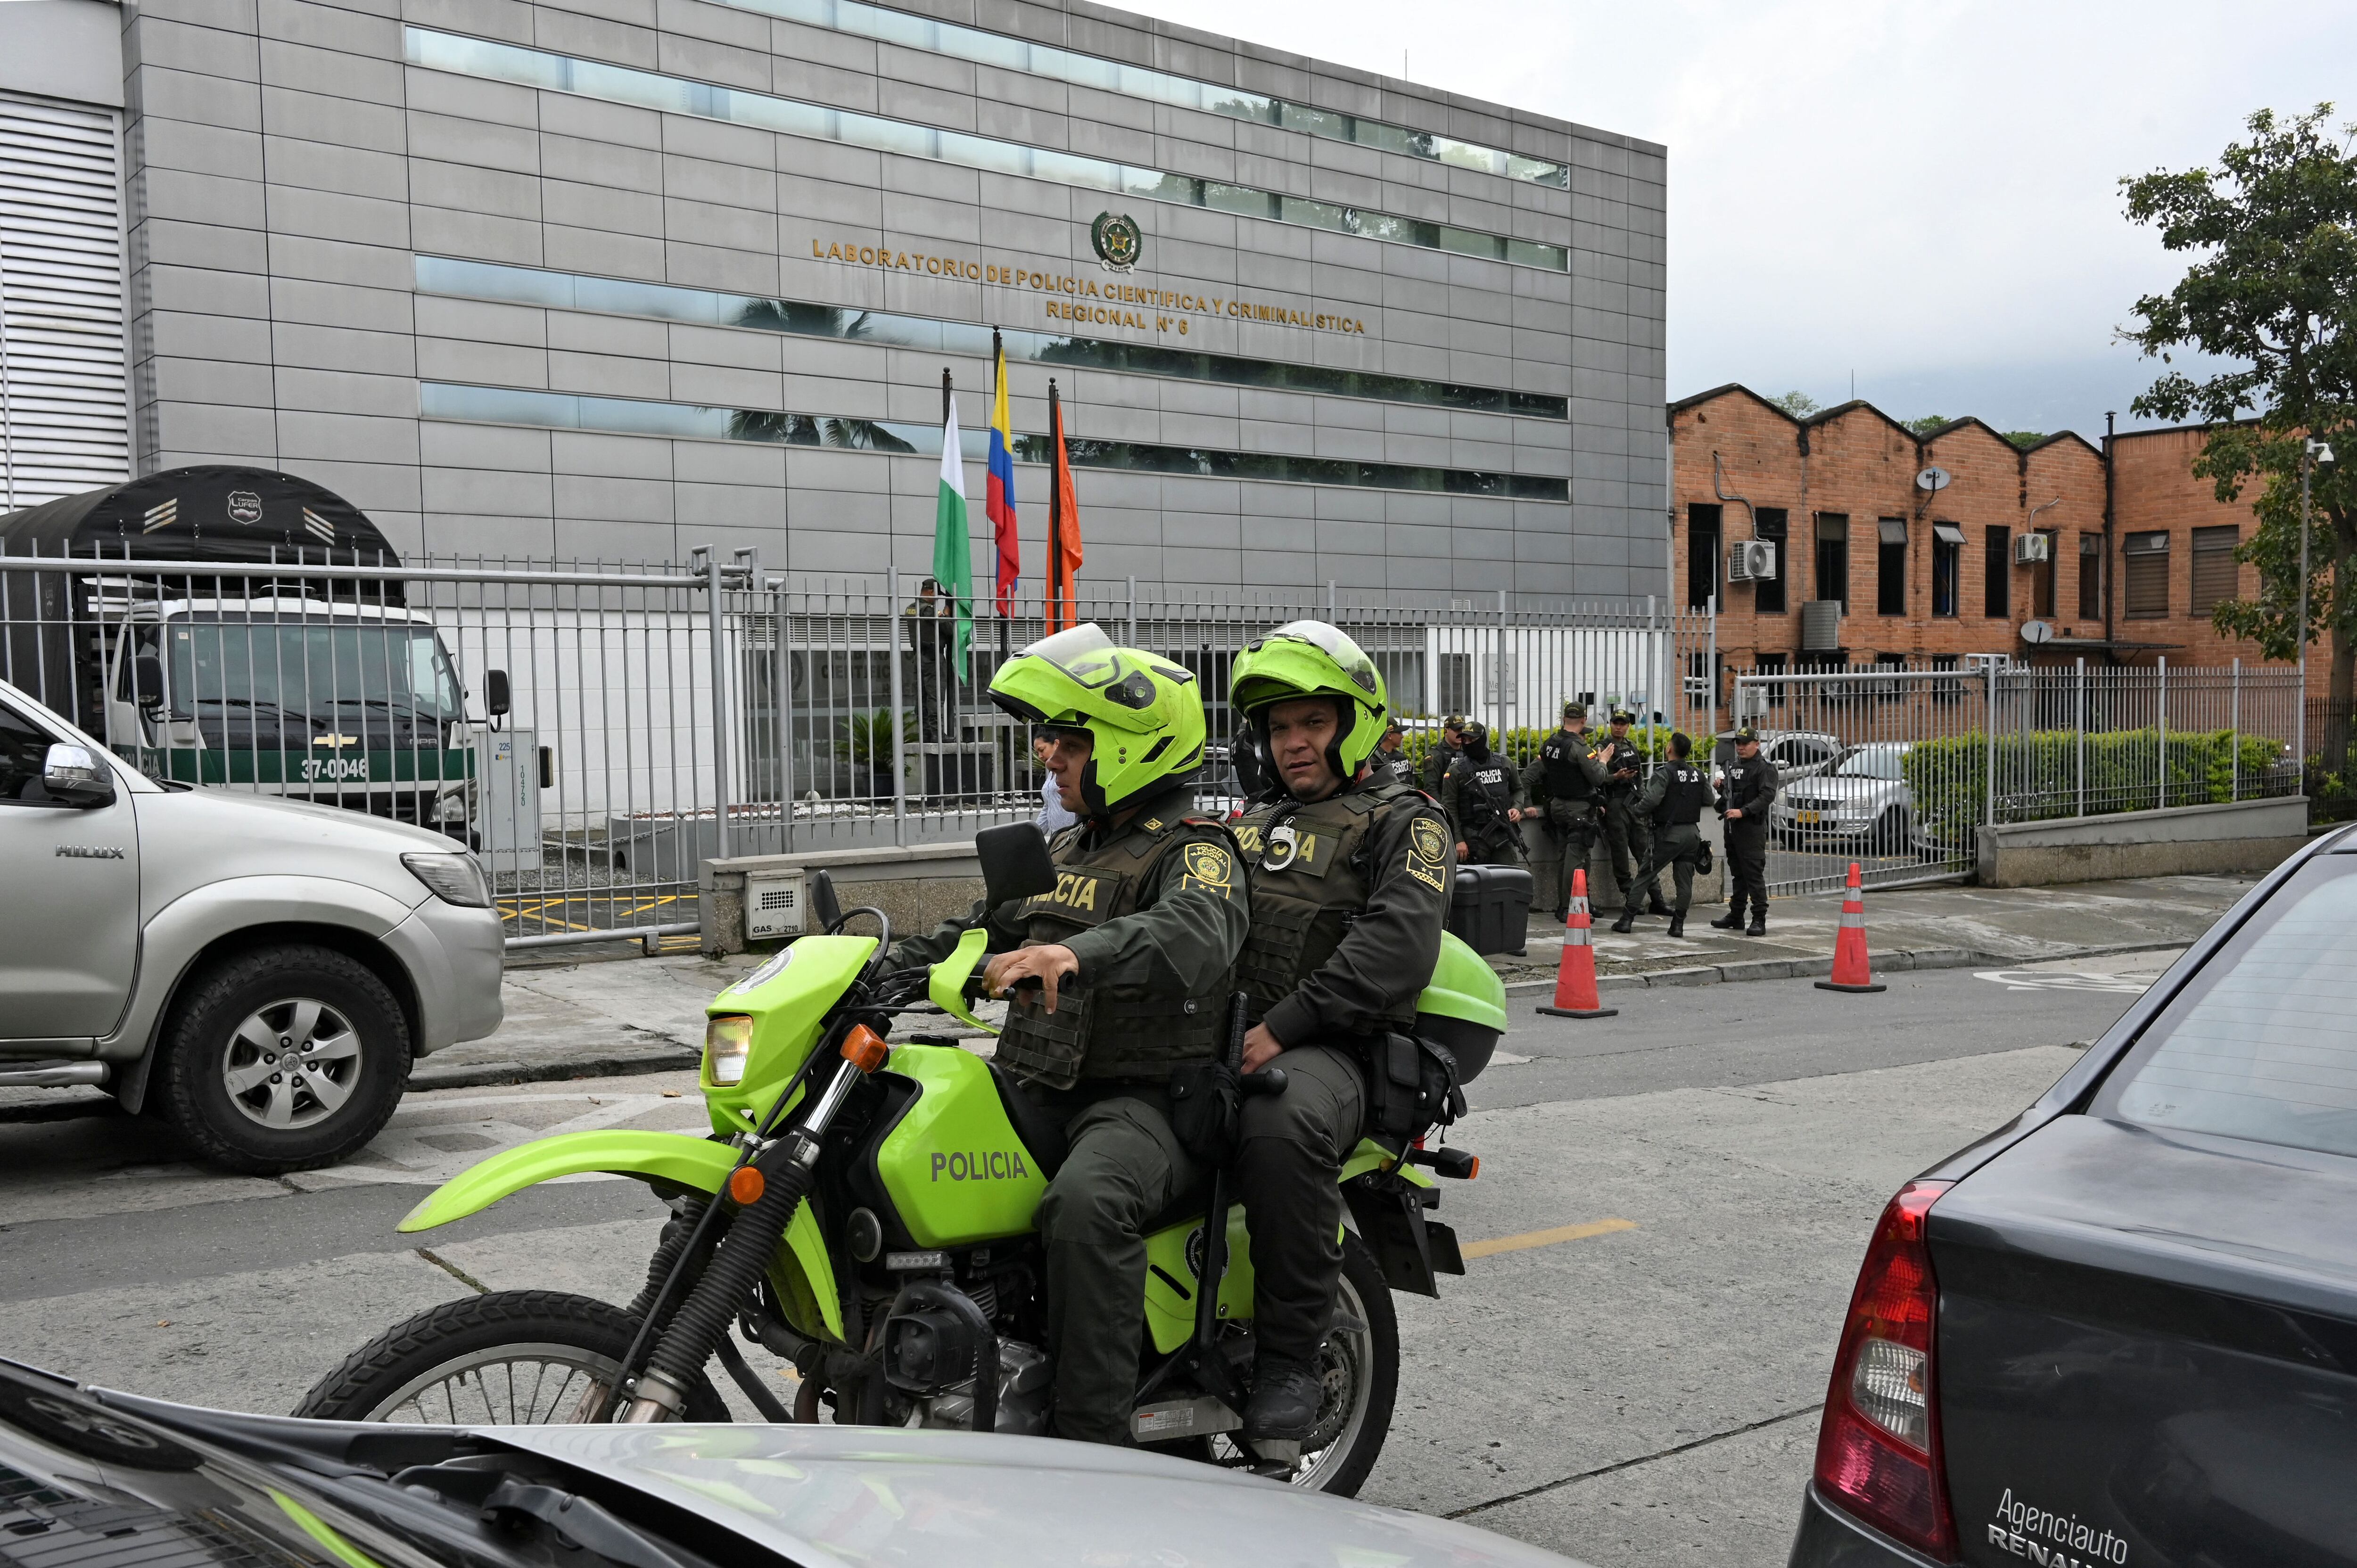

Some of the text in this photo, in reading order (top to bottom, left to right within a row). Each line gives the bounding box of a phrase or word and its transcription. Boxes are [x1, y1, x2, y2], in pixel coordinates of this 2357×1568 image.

[813, 239, 1365, 334] LABORATORIO DE POLICIA CIENTIFICA Y CRIMINALISTICA
[1046, 301, 1146, 329] REGIONAL
[1178, 319, 1188, 335] 6
[231, 497, 258, 509] LUFER
[499, 742, 510, 751] 225
[119, 753, 161, 774] POLCIA
[301, 758, 366, 779] 37-0046
[1475, 769, 1502, 778] POLICIA
[56, 845, 124, 860] HILUX
[753, 925, 772, 933] GAS
[931, 1151, 1029, 1182] POLICIA
[1996, 1488, 2127, 1565] Agenciauto
